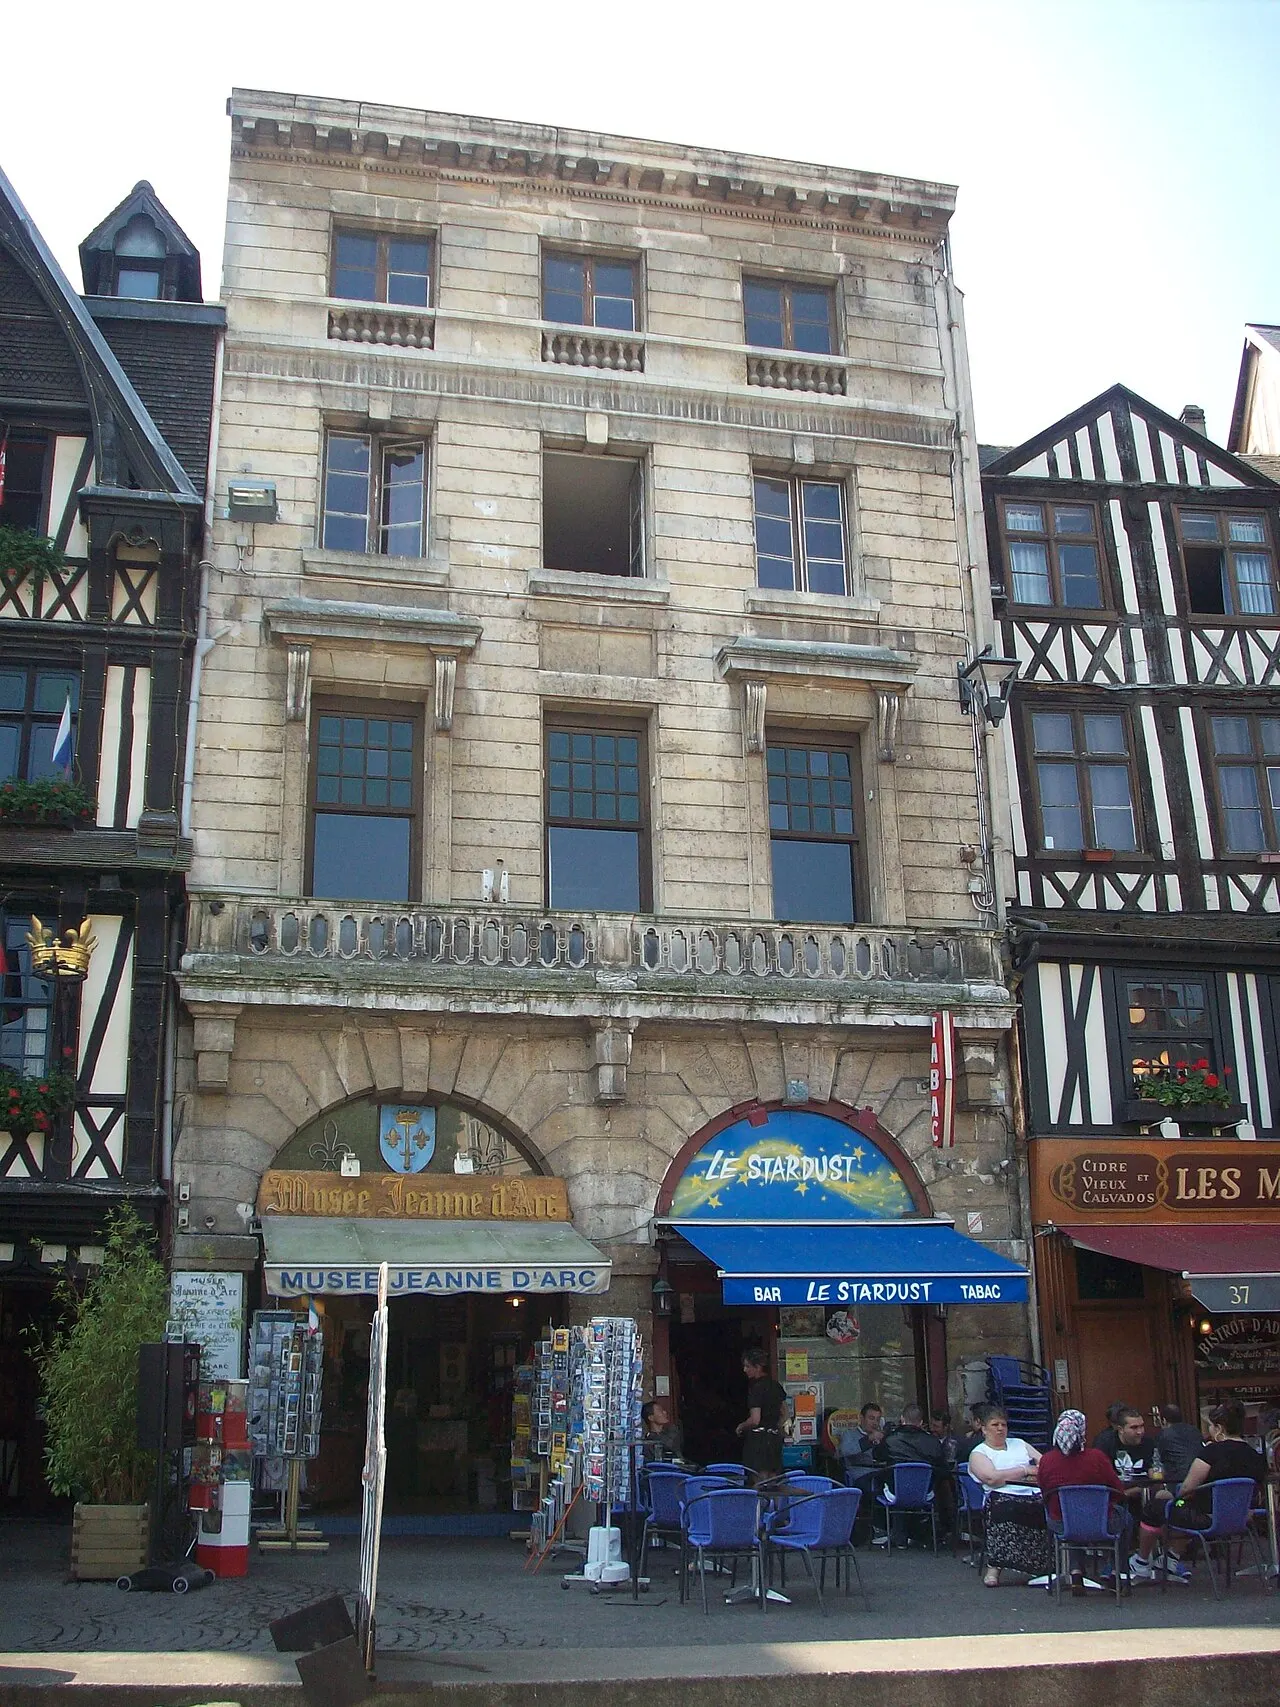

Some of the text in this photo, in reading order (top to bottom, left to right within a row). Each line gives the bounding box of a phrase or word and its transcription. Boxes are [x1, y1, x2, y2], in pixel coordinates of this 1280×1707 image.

[930, 1016, 940, 1143] TABAC
[705, 1149, 857, 1185] LE STARDUST
[1082, 1159, 1128, 1172] CIDRE
[1081, 1176, 1127, 1190] VIEUX
[1137, 1174, 1150, 1182] ET
[1176, 1167, 1242, 1200] LES
[266, 1173, 558, 1219] Musée Jeanne d'Arc
[1082, 1190, 1155, 1203] CALVADOS
[280, 1270, 597, 1289] MUSEE JEANNE D'ARC
[753, 1286, 782, 1302] BAR
[806, 1281, 933, 1303] LE STARDUST
[960, 1284, 1001, 1300] TABAC
[1229, 1285, 1250, 1305] 37
